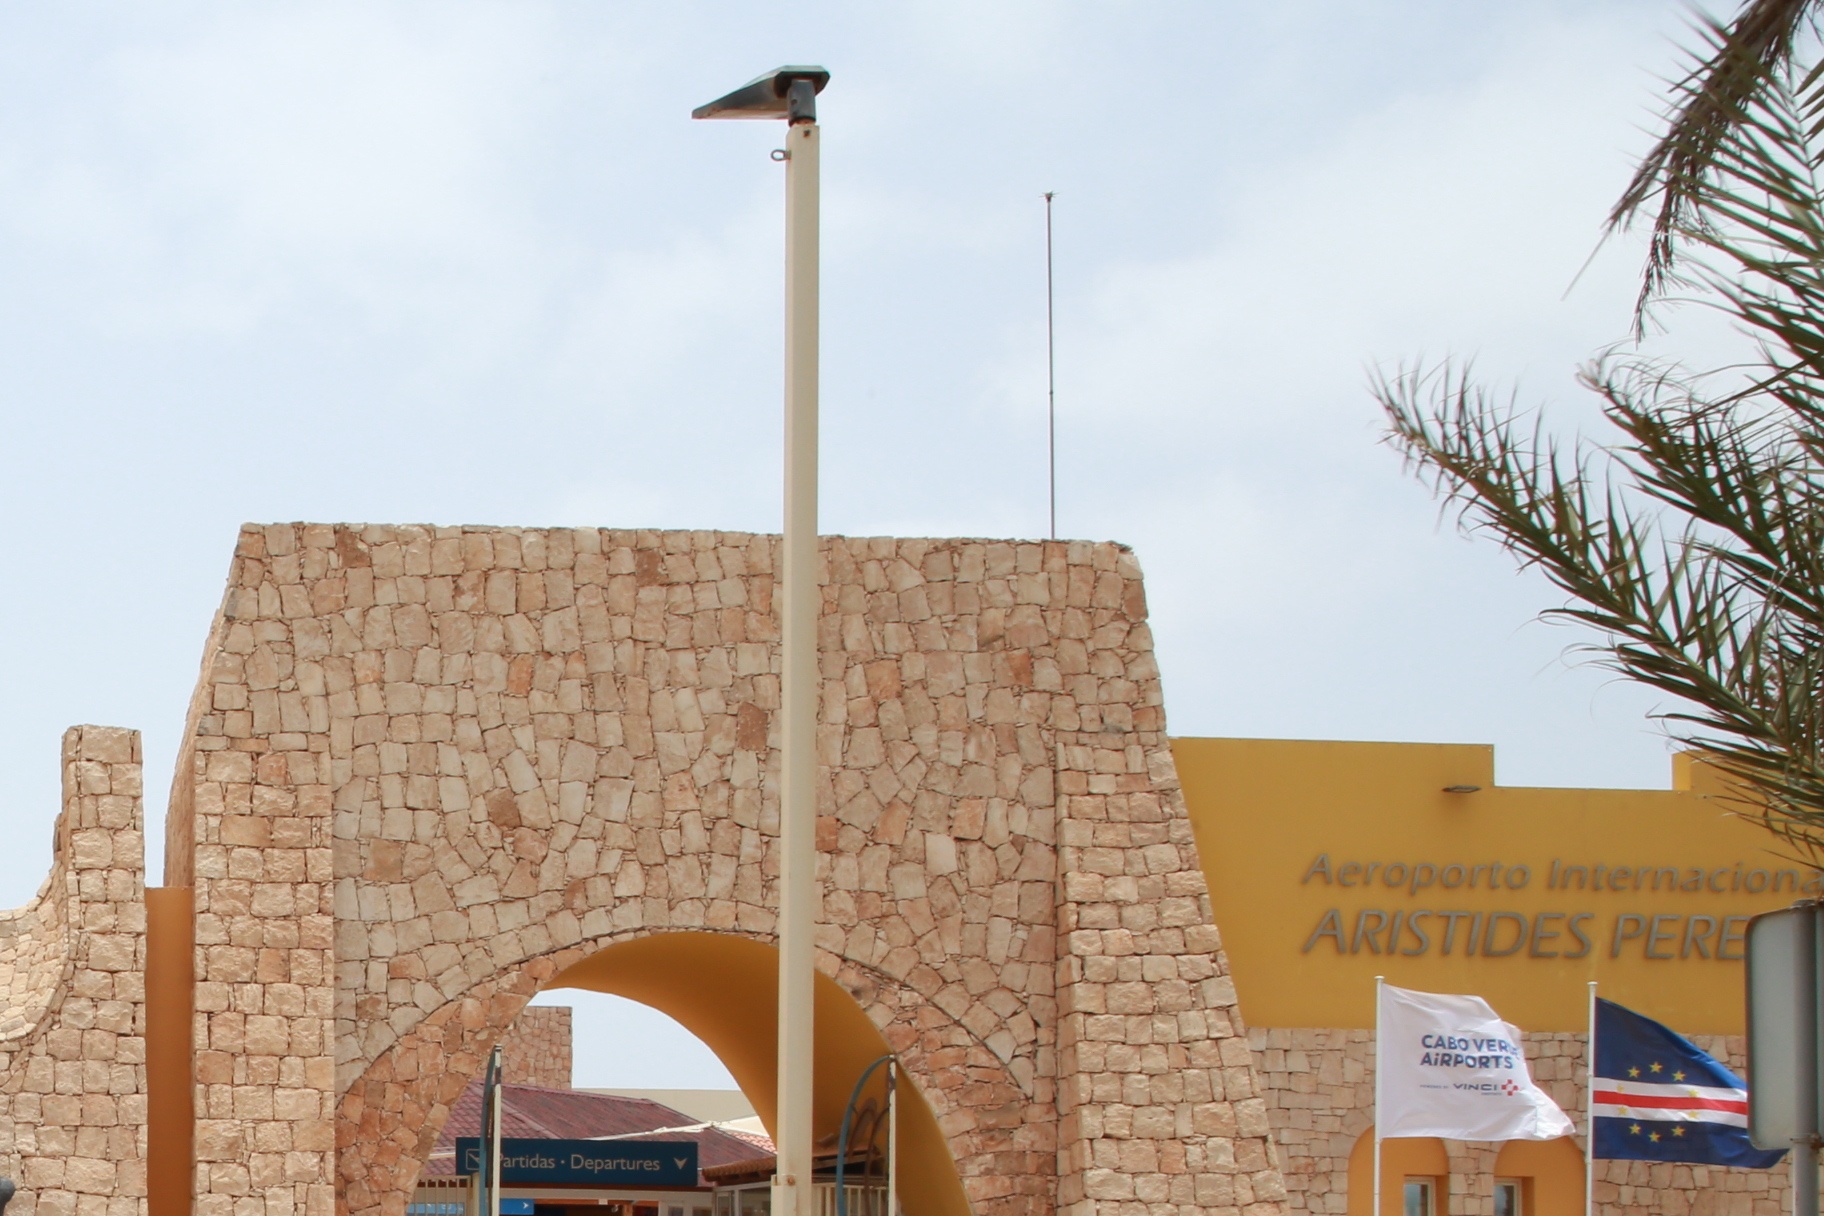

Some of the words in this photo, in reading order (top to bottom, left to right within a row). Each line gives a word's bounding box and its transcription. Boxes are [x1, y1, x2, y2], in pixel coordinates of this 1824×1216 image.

[1302, 853, 1532, 897] Aeroporto
[1302, 907, 1596, 960] ARISTIDES
[1420, 1034, 1470, 1052] CABO
[1473, 1038, 1519, 1056] VER
[1452, 1083, 1498, 1091] VINCI
[570, 1153, 661, 1174] Departures
